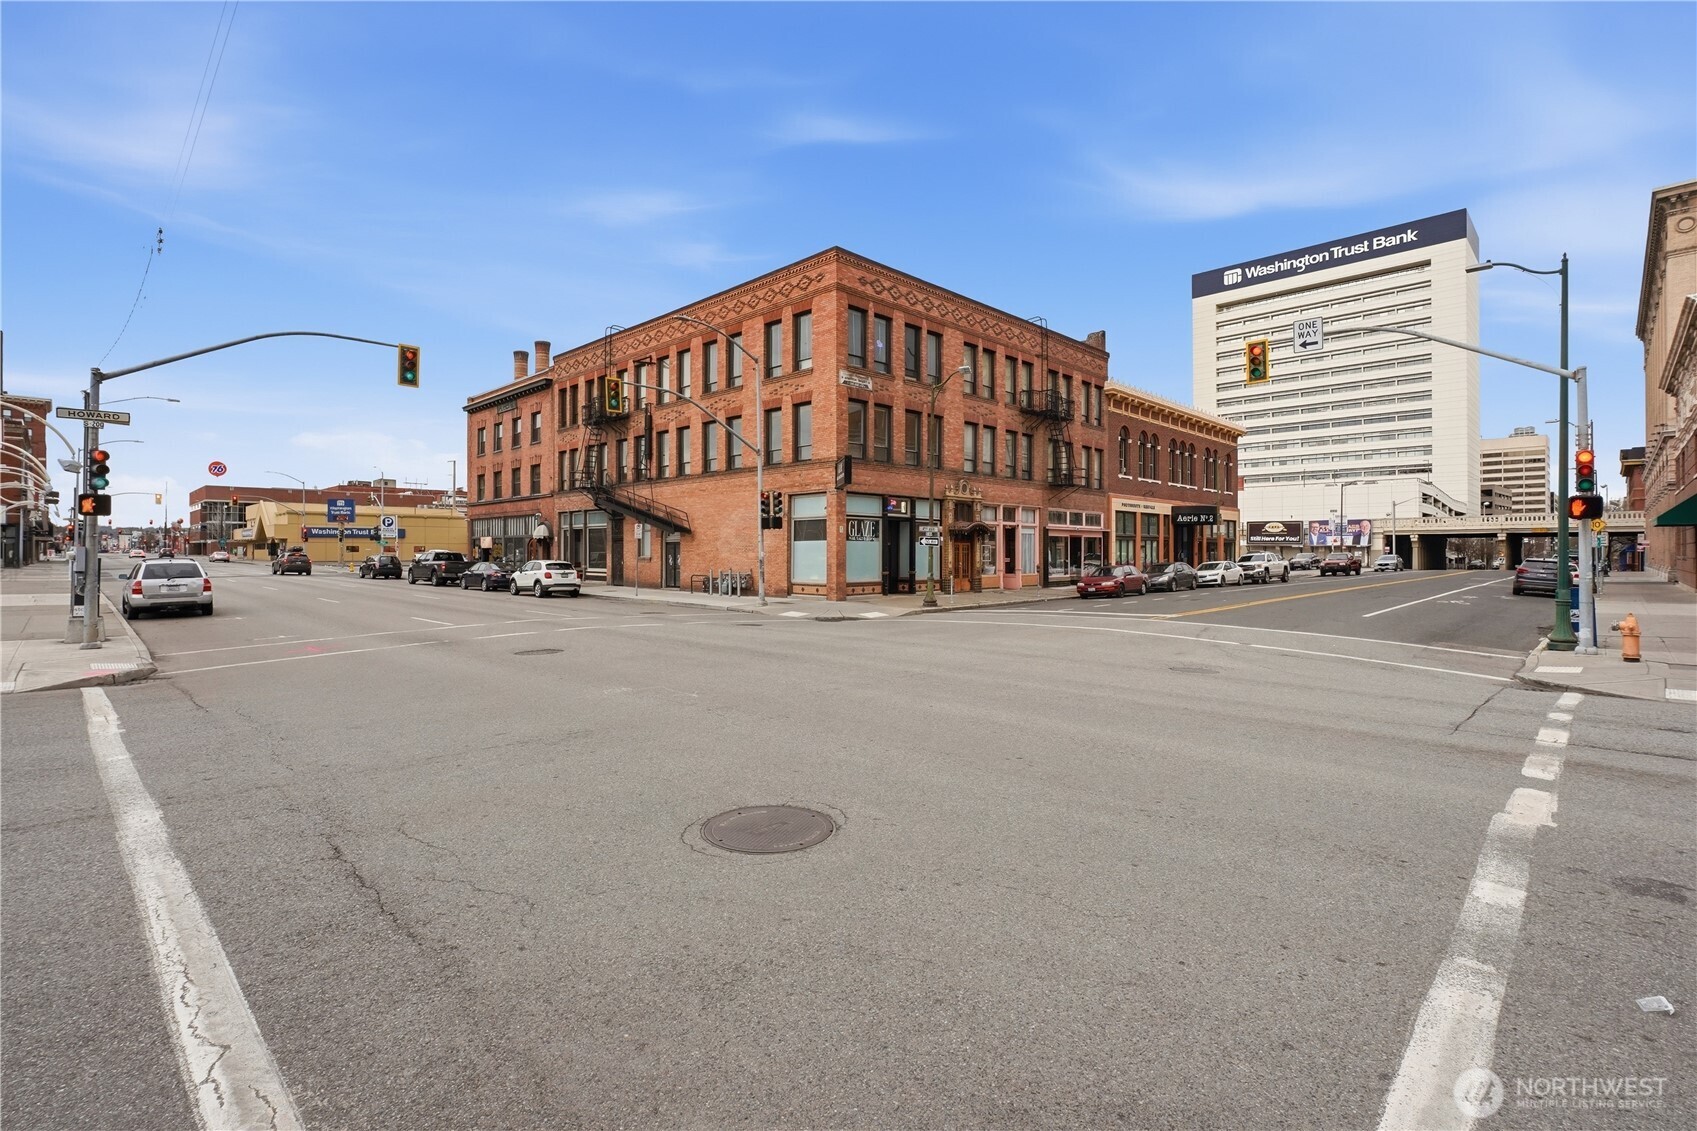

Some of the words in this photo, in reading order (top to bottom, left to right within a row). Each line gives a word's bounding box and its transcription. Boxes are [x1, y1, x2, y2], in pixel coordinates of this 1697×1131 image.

[1245, 250, 1329, 279] Washington
[1330, 240, 1369, 259] Trust
[1373, 229, 1419, 250] Bank
[1298, 320, 1318, 331] ONE
[1297, 329, 1319, 340] WAY
[67, 410, 120, 420] HOWARD
[211, 465, 224, 473] 76
[1177, 514, 1198, 522] Aerie
[311, 528, 351, 536] Washingon
[848, 520, 876, 537] GLAZE
